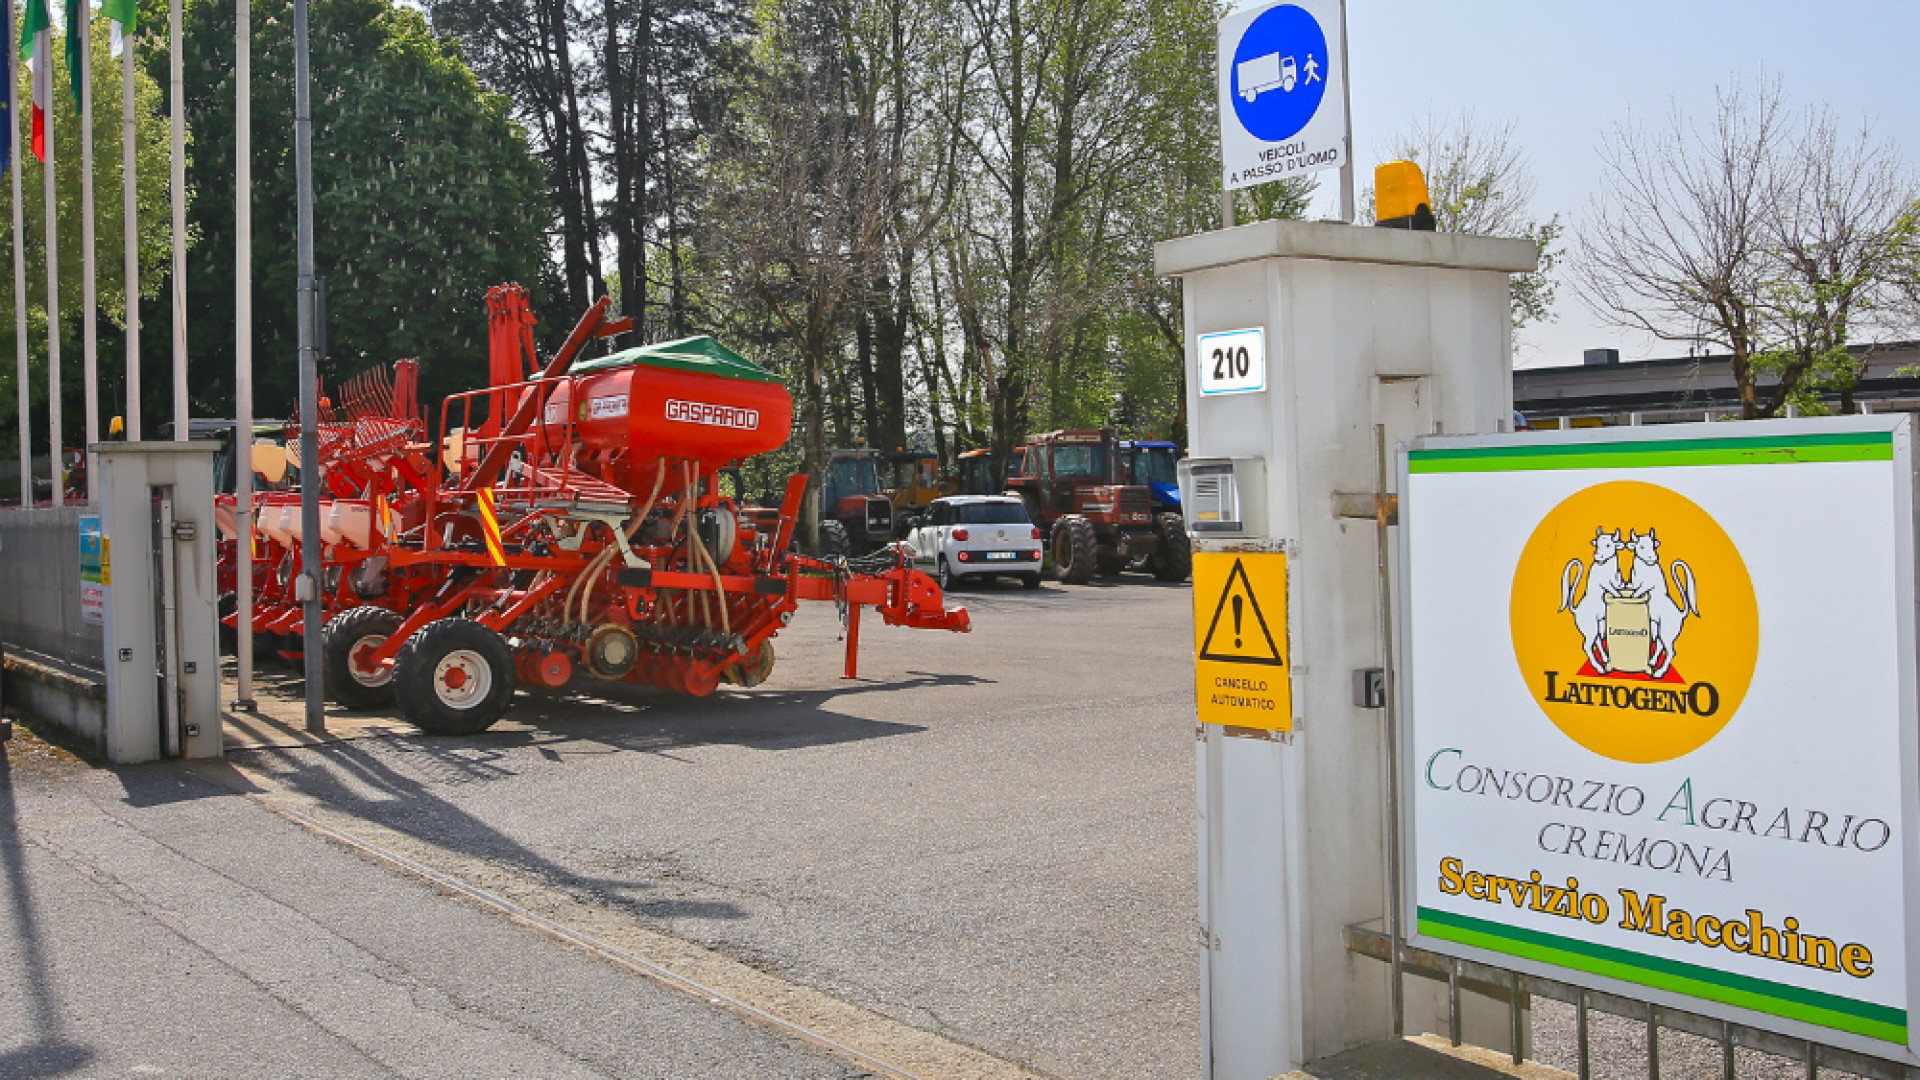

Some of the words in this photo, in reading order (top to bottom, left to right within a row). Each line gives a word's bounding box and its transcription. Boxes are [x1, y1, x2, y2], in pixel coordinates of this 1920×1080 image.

[1231, 172, 1239, 184] A
[1243, 161, 1282, 180] PASSO
[1288, 148, 1337, 171] D'UOMO
[1259, 142, 1305, 161] VEICOLI
[1212, 346, 1250, 380] 210
[667, 401, 758, 429] GASPARDO
[1215, 677, 1267, 691] CANCELLO
[1544, 671, 1719, 716] LATTOGENO
[1211, 694, 1275, 710] AUTOMATICO
[1425, 748, 1645, 815] CONSORZIO
[1657, 776, 1890, 852] AGRARIO
[1538, 822, 1735, 882] CREMONA
[1438, 857, 1609, 924] Servizio
[1619, 889, 1874, 977] Macchine
